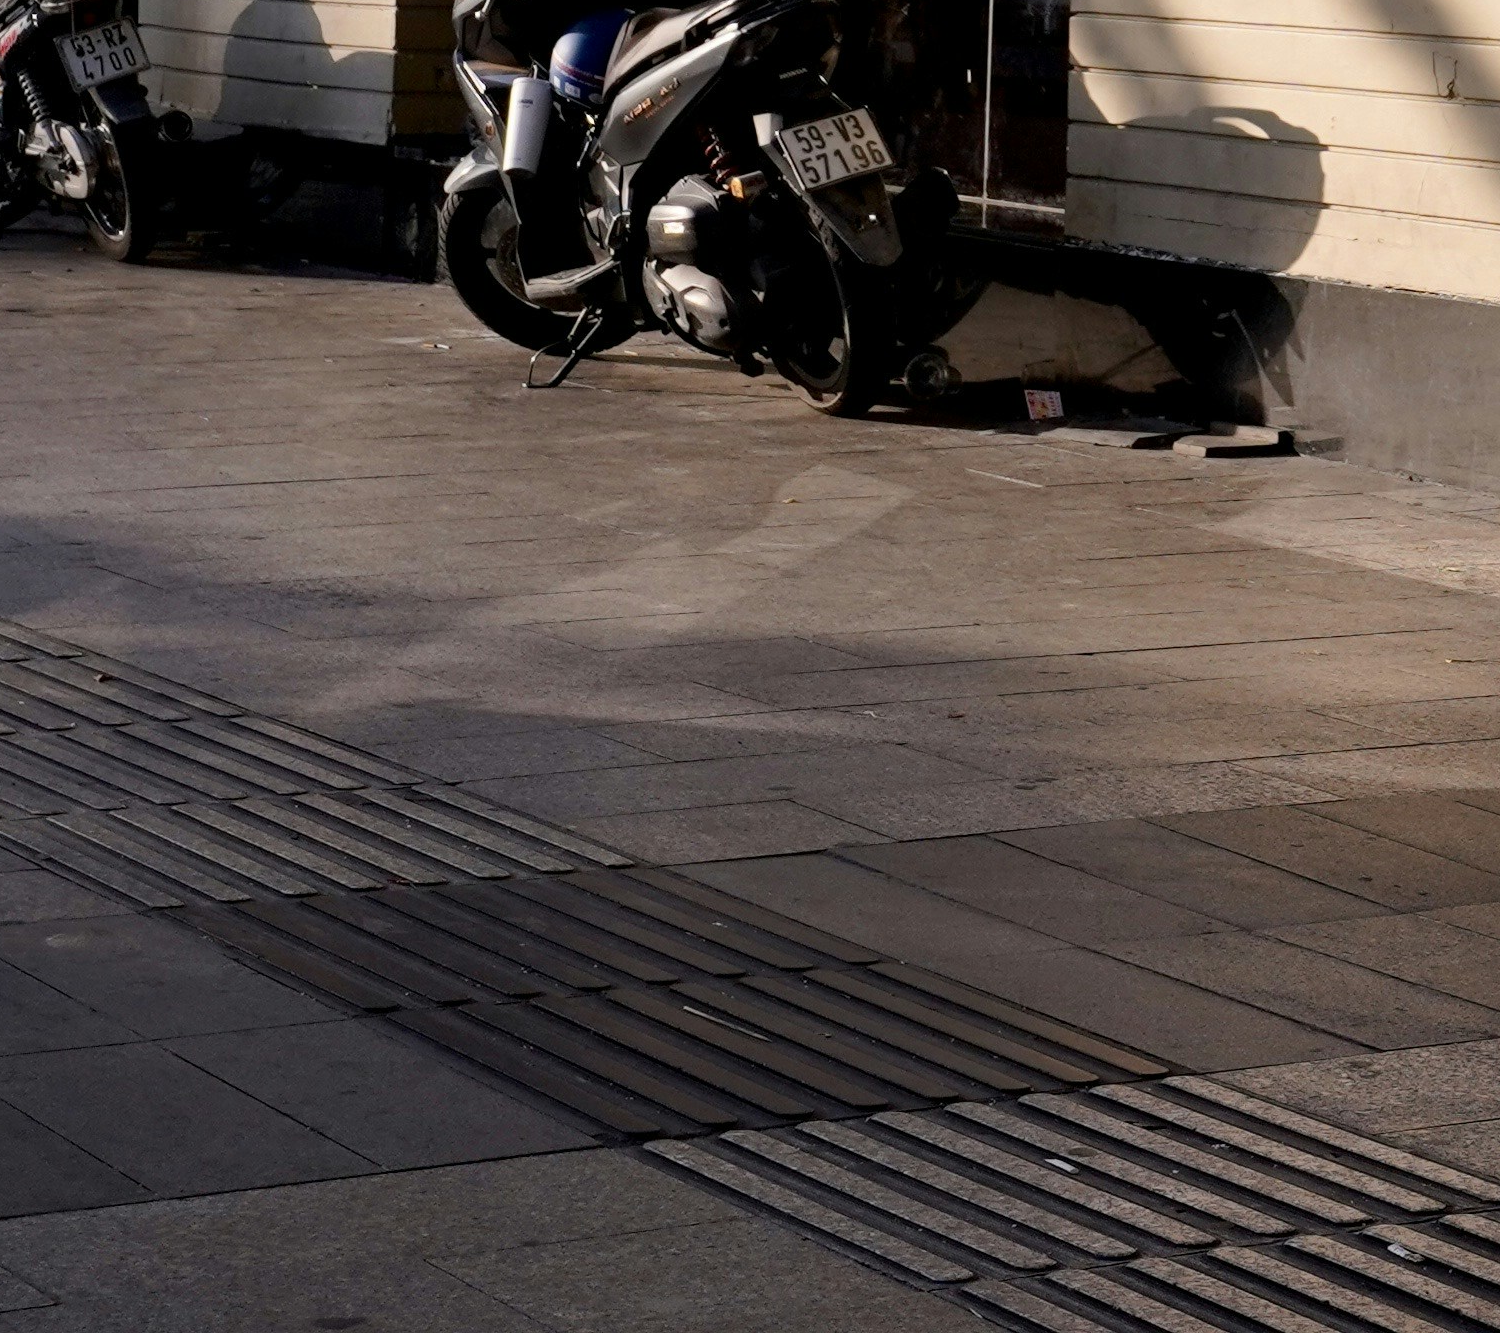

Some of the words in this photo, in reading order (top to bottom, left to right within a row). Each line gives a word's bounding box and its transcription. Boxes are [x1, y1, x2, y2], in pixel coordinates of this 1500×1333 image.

[82, 47, 137, 80] 4700
[792, 114, 866, 154] 59-V3
[799, 140, 887, 184] 571.96
